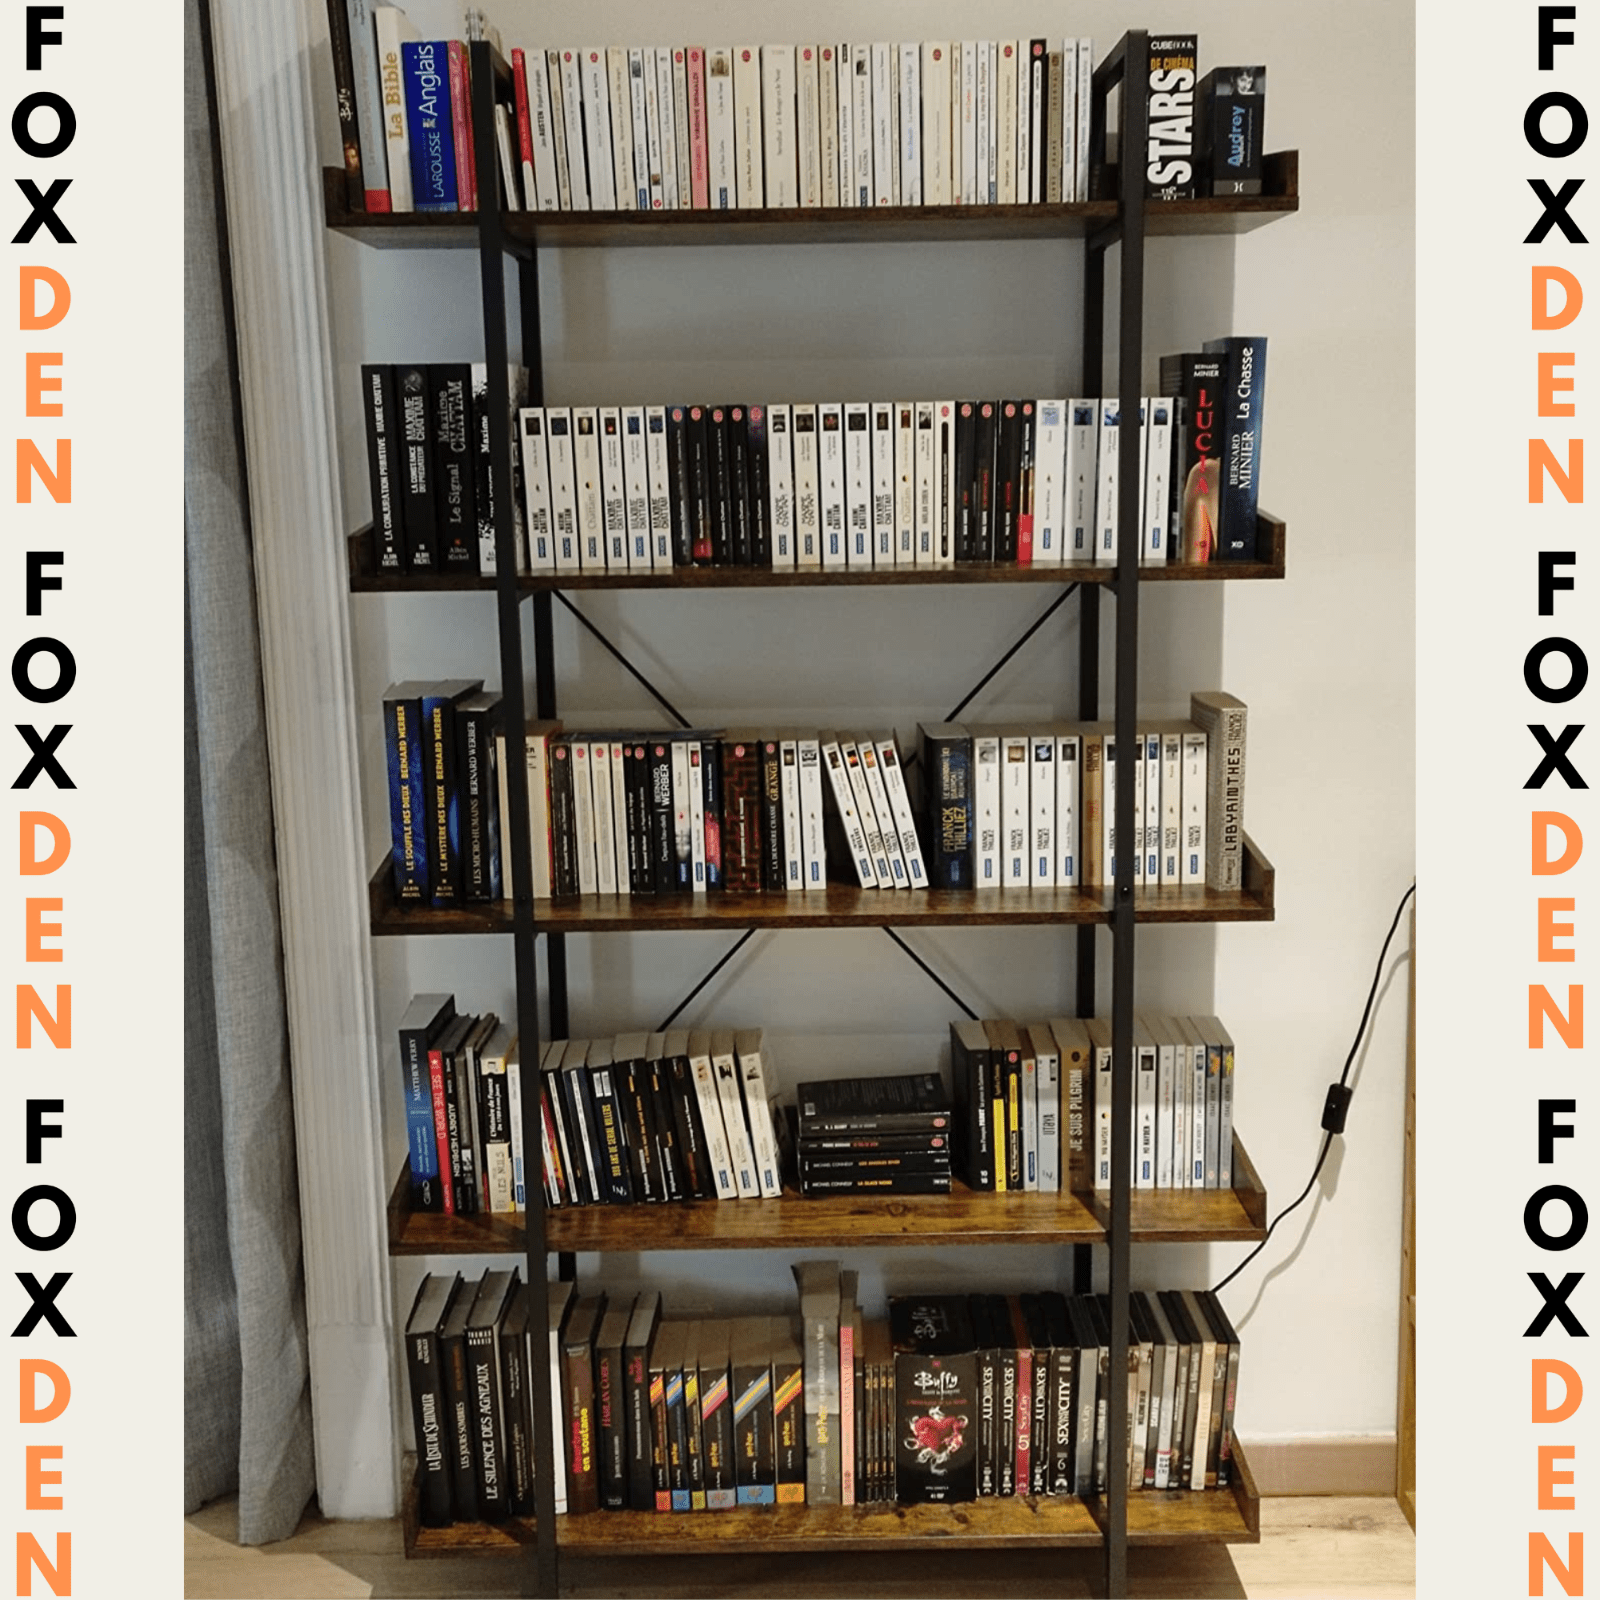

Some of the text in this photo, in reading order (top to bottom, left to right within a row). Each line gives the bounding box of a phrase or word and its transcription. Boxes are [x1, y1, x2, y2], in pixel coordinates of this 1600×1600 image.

[383, 52, 404, 139] La Bible
[413, 44, 441, 116] Anglais
[1147, 68, 1195, 184] STARS
[1228, 105, 1246, 167] Audrey
[428, 131, 444, 198] LAROUSSE
[1237, 346, 1253, 419] La Chasse
[404, 396, 415, 441] MAXIME
[414, 396, 426, 441] CHATTAM
[437, 390, 450, 443] Maxime
[447, 380, 466, 453] CHATTAM
[480, 415, 490, 453] Maxime
[1230, 434, 1240, 486] BERNARD
[1239, 430, 1255, 489] MINIER
[446, 463, 463, 523] Le Signal
[384, 529, 393, 541] LA
[397, 705, 409, 779] BERNARD WERBER
[433, 708, 444, 780] BERNARD WERBER
[467, 721, 479, 795] BERNARD WERBER
[436, 785, 445, 808] DIEUX
[653, 768, 661, 803] BERNARD
[660, 764, 670, 806] WERBER
[1224, 748, 1240, 851] LABYRINTHES
[401, 785, 414, 871] LE SOUFFLE DES DIEUX
[437, 810, 446, 824] DES
[470, 798, 482, 884] LES MICRO-HUMAINS
[942, 806, 954, 852] FRANCK
[953, 806, 967, 851] THILLIEZ
[440, 862, 448, 871] LE
[770, 830, 778, 860] DERNIÈRE
[772, 861, 778, 869] LA
[409, 1038, 422, 1102] MATTHEW PERRY
[487, 1078, 495, 1098] France
[488, 1099, 495, 1108] de
[1069, 1069, 1082, 1151] JE SUIS PILGRIM
[448, 1103, 460, 1177] AUDREY HEPBURN
[914, 1371, 958, 1401] Buffy
[456, 1402, 467, 1435] SOMBRES
[476, 1363, 498, 1500] LE SILENCE DES AGNEAUX
[579, 1407, 591, 1471] en soutane
[428, 1460, 441, 1470] LA
[458, 1435, 470, 1456] JOURS
[460, 1456, 470, 1468] LES
